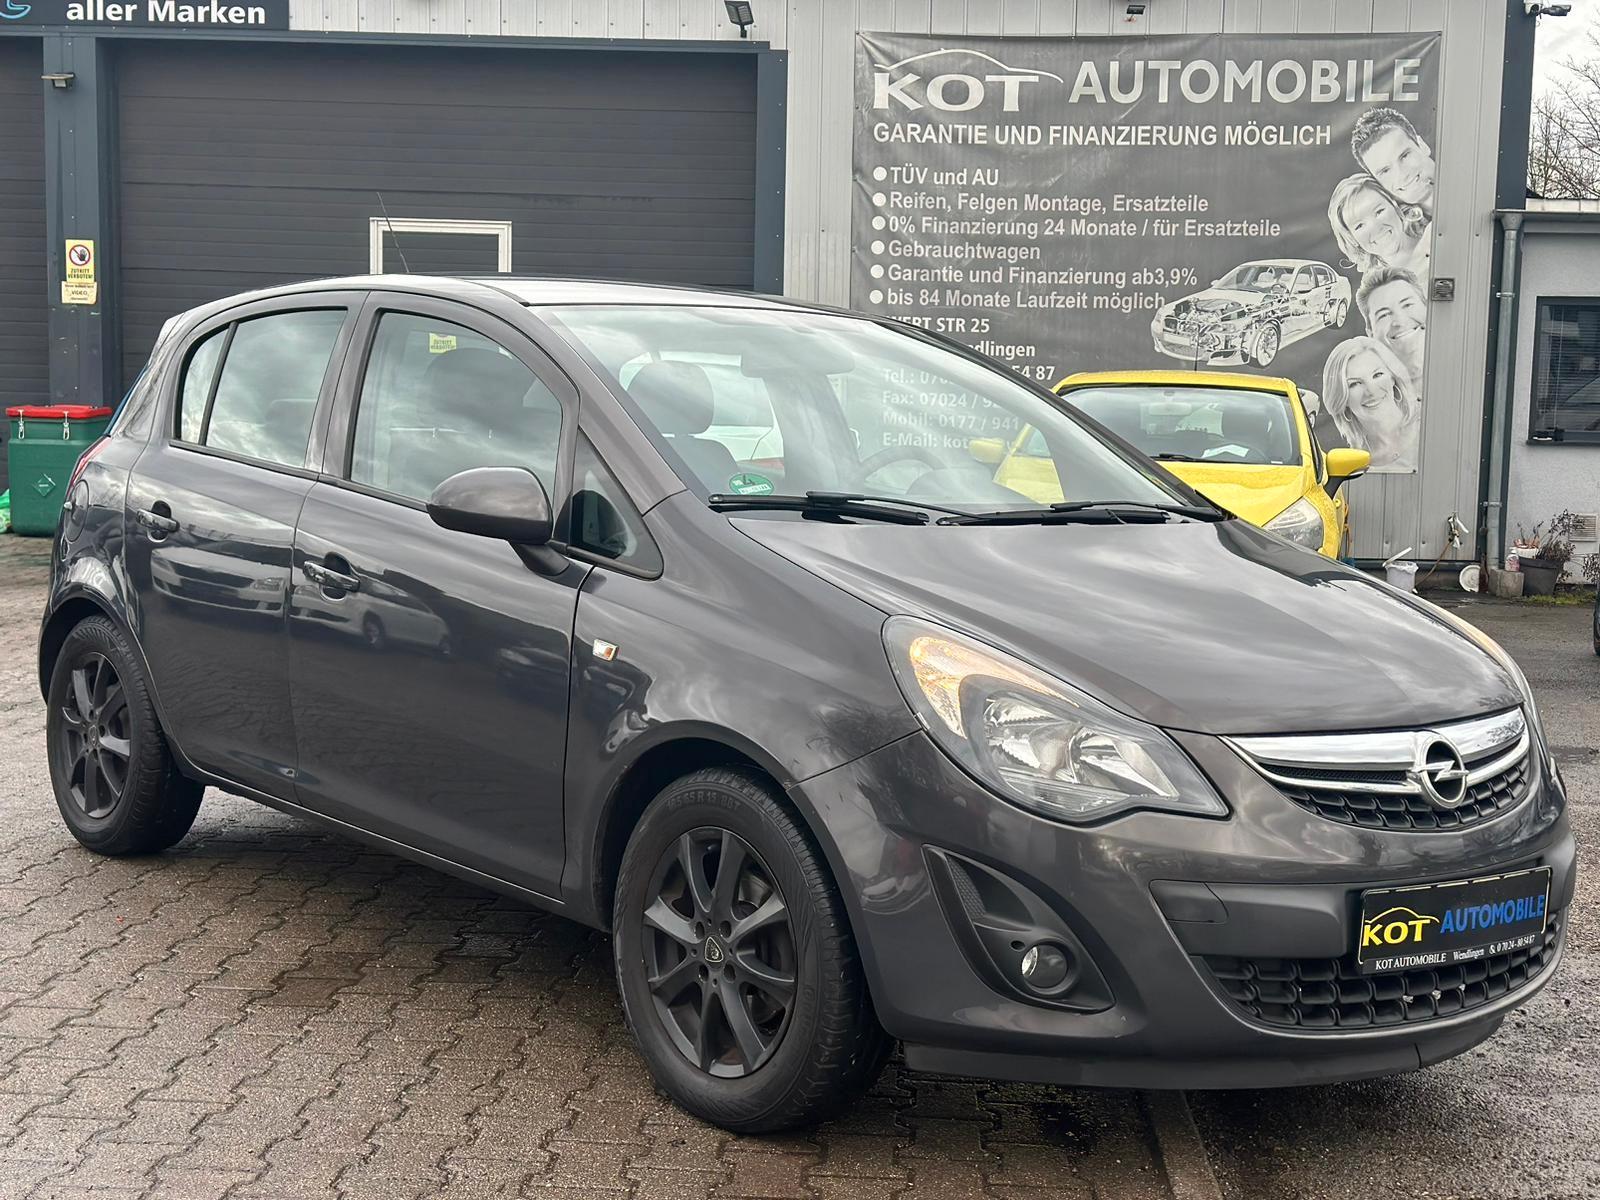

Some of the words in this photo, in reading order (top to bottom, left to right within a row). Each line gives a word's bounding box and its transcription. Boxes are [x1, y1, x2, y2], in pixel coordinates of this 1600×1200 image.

[66, 0, 137, 21] aller
[148, 0, 266, 24] Marken
[873, 72, 1040, 112] KOT
[1068, 58, 1421, 104] AUTOMOBILE
[873, 123, 987, 144] GARANTIE
[995, 125, 1041, 145] UND
[1049, 125, 1217, 146] FINANZIERUNG
[1224, 121, 1331, 146] MÖGLICH
[890, 164, 928, 184] TÜV
[933, 168, 967, 185] und
[972, 169, 999, 185] AU
[890, 192, 951, 212] Reifen,
[958, 193, 1017, 215] Felgen
[1024, 194, 1106, 215] Montage,
[1113, 194, 1209, 212] Ersatzteile
[889, 216, 915, 233] 0%
[921, 216, 1038, 238] Finanzierung
[1044, 219, 1064, 235] 24
[1071, 219, 1137, 236] Monate
[1142, 219, 1149, 236] /
[1153, 219, 1179, 236] für
[1184, 219, 1280, 237] Ersatzteile
[888, 240, 1040, 263] Gebrauchtwagen
[887, 264, 963, 283] Garantie
[969, 267, 1002, 284] und
[1009, 267, 1126, 288] Finanzierung
[1132, 268, 1198, 287] ab3,9%
[887, 289, 911, 305] bis
[919, 290, 939, 306] 84
[946, 291, 1010, 307] Monate
[1017, 292, 1088, 309] Laufzeit
[1094, 293, 1165, 313] möglich
[937, 318, 966, 332] STR
[971, 319, 990, 333] 25
[968, 341, 1035, 360] dlingen
[1036, 366, 1055, 380] 87
[883, 390, 913, 405] Fax:
[920, 392, 966, 407] 07024
[883, 411, 933, 427] Mobil:
[939, 414, 978, 428] 0177
[883, 432, 937, 448] E-Mail:
[944, 434, 969, 449] kot
[1362, 919, 1430, 946] KOT
[1440, 895, 1545, 934] AUTOMOBILE
[1375, 957, 1393, 970] KOT
[1393, 953, 1447, 968] AUTOMOBILE
[1453, 948, 1485, 960] Wendlingen
